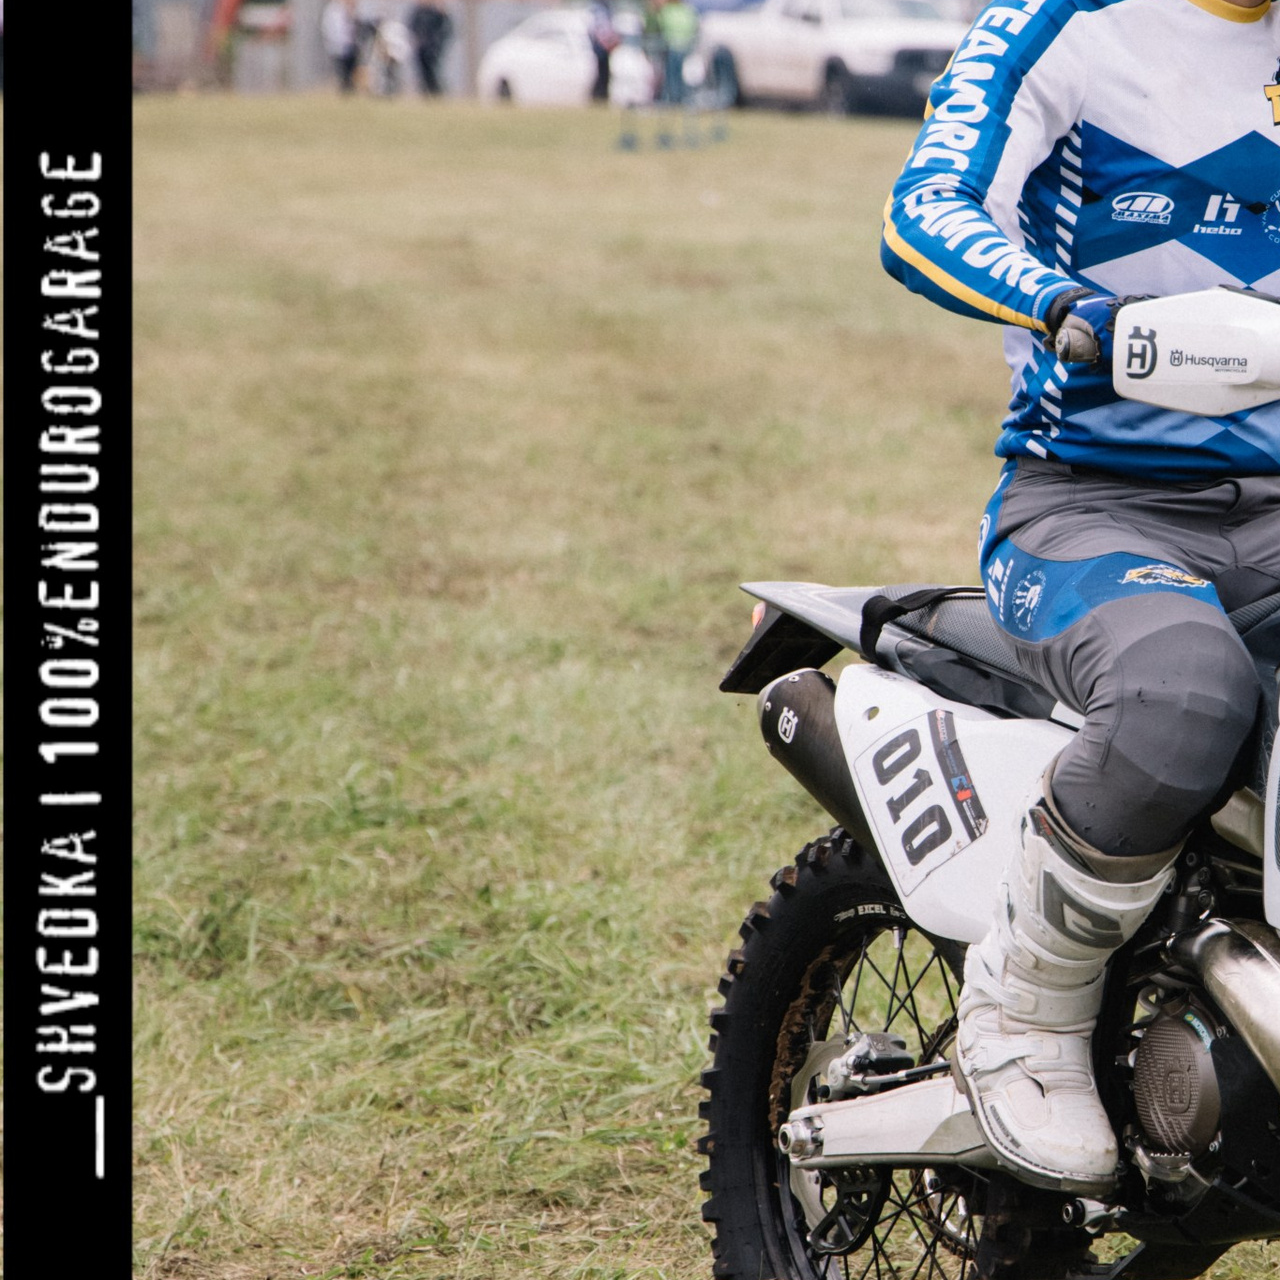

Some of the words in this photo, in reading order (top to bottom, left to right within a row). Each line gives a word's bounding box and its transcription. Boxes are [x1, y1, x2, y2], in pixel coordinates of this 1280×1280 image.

[1193, 224, 1243, 235] hebo
[1185, 354, 1248, 367] Husqvarna
[872, 727, 952, 867] 010
[857, 904, 886, 915] EXCEL
